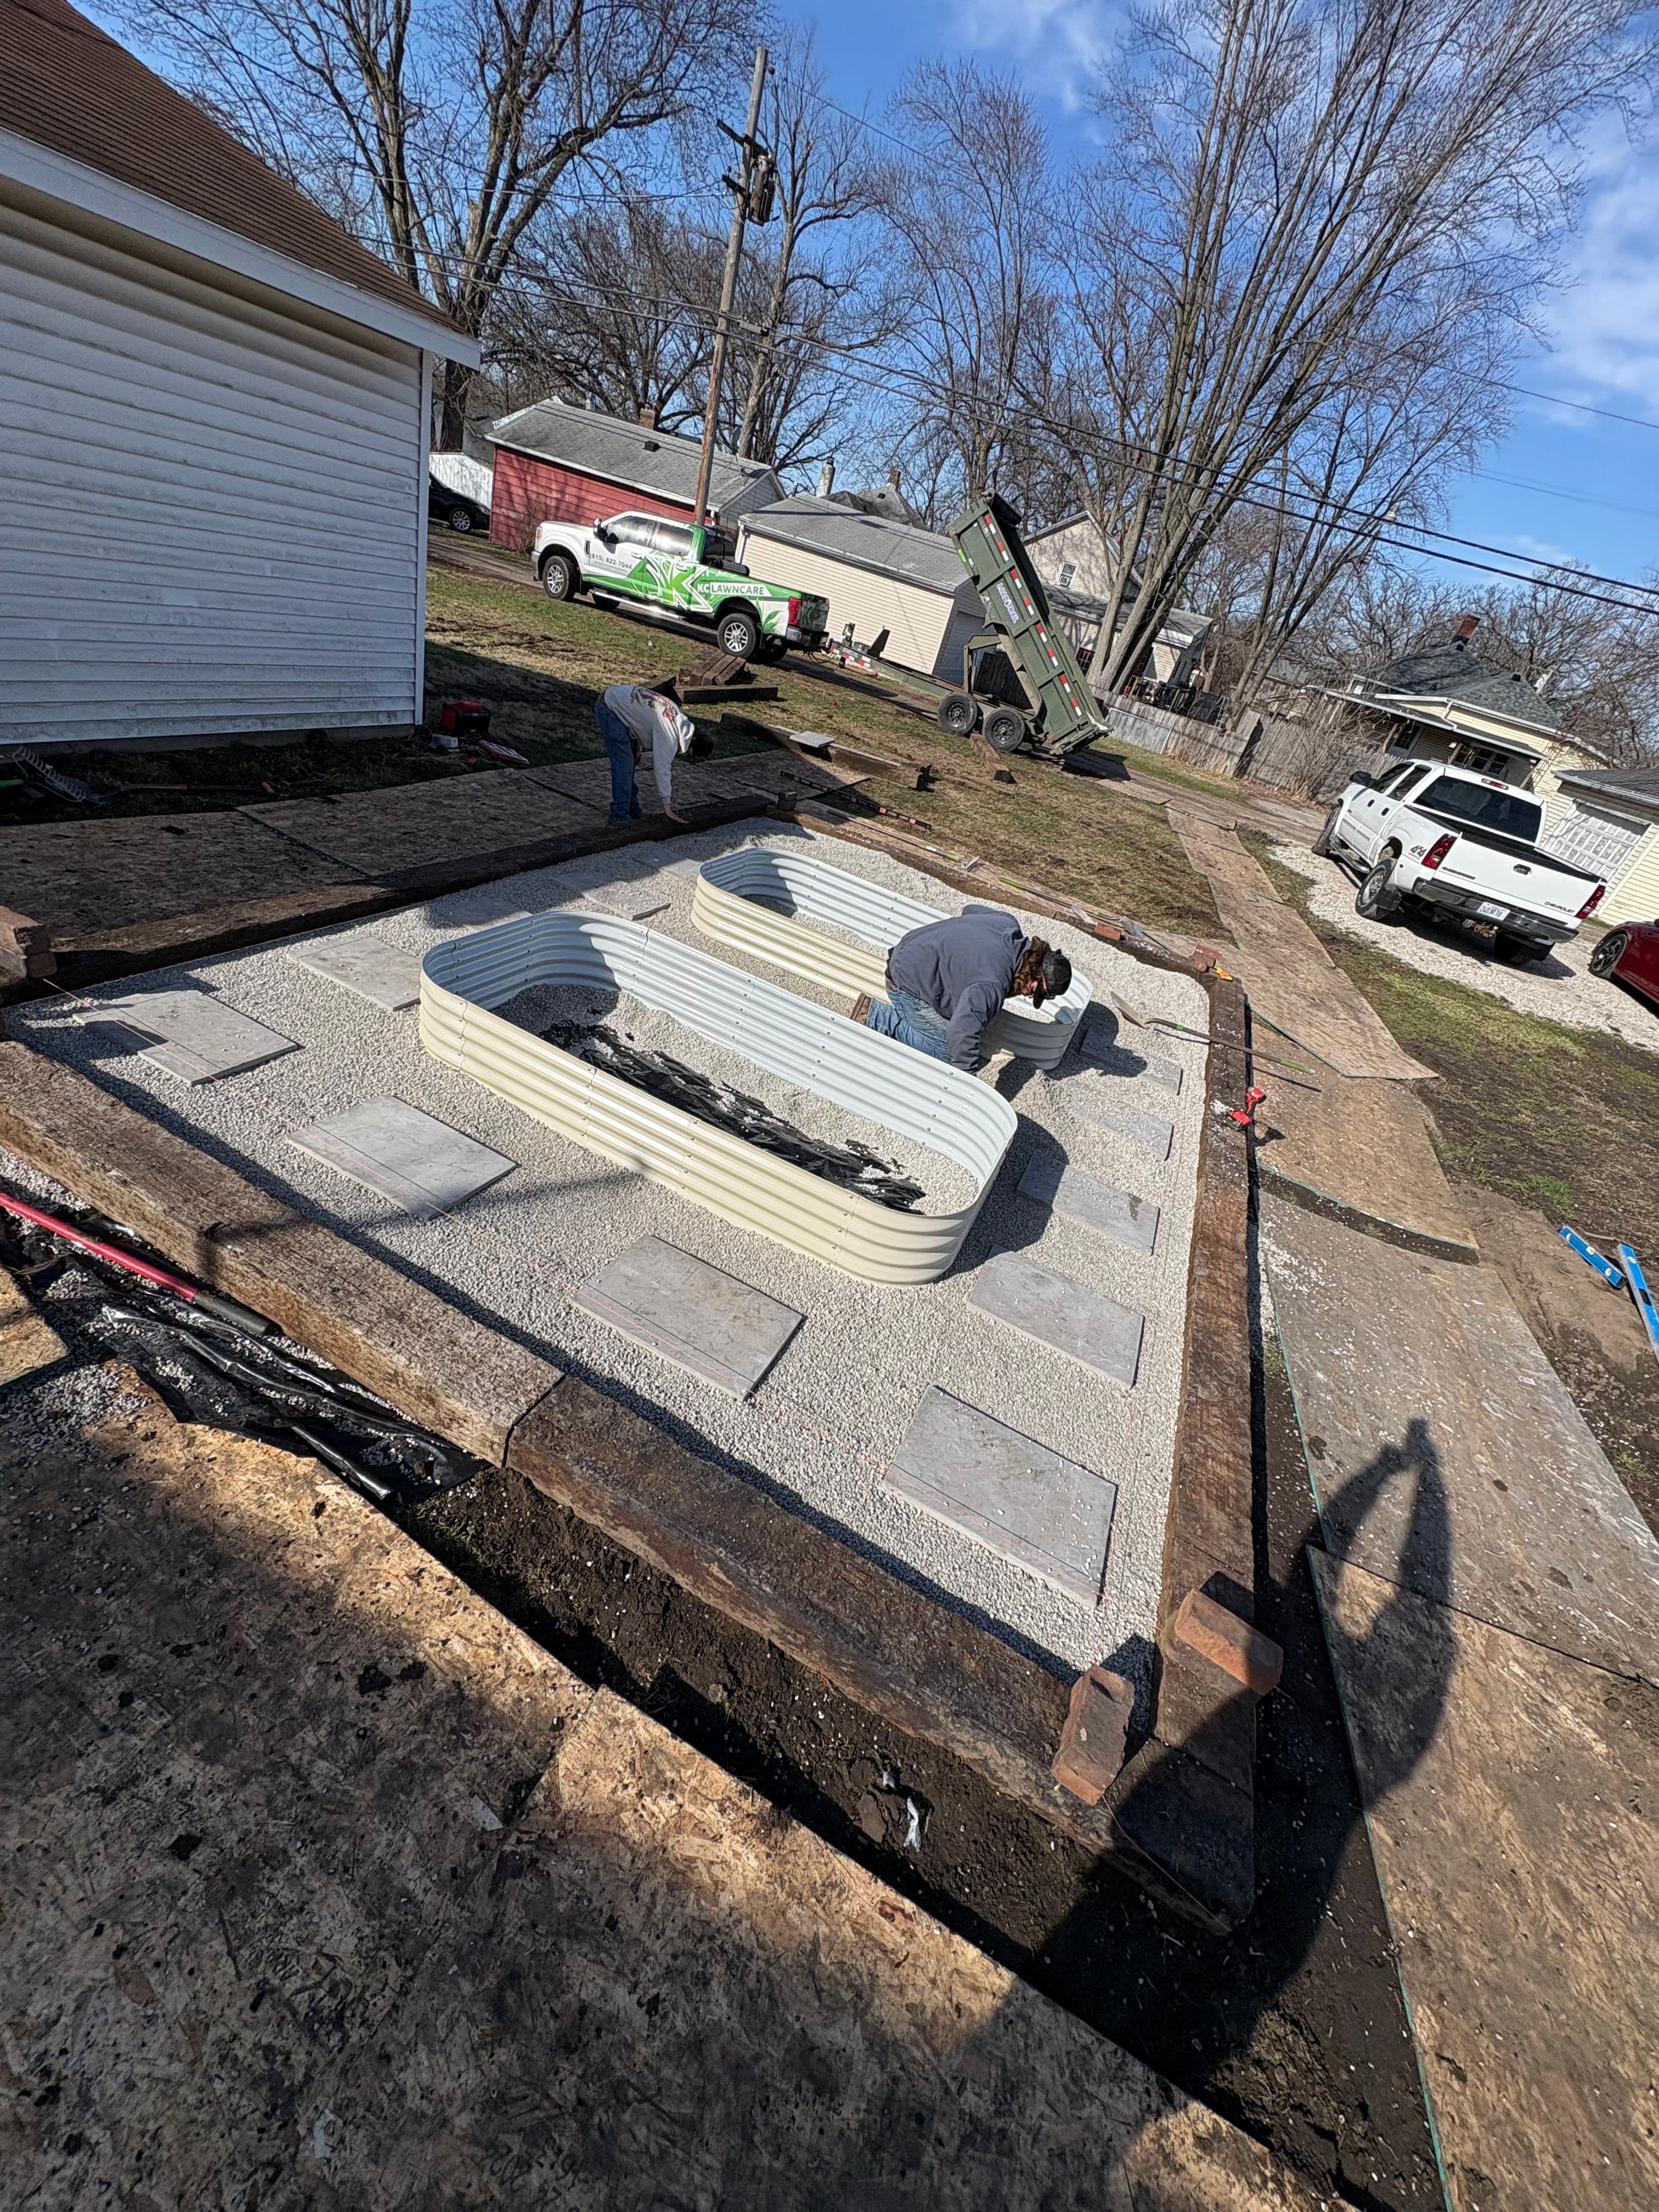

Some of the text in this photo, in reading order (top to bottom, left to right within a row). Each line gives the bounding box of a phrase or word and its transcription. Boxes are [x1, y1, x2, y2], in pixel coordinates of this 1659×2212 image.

[697, 583, 764, 595] KC LAWNCARE
[996, 582, 1020, 623] LOAD TRAIL
